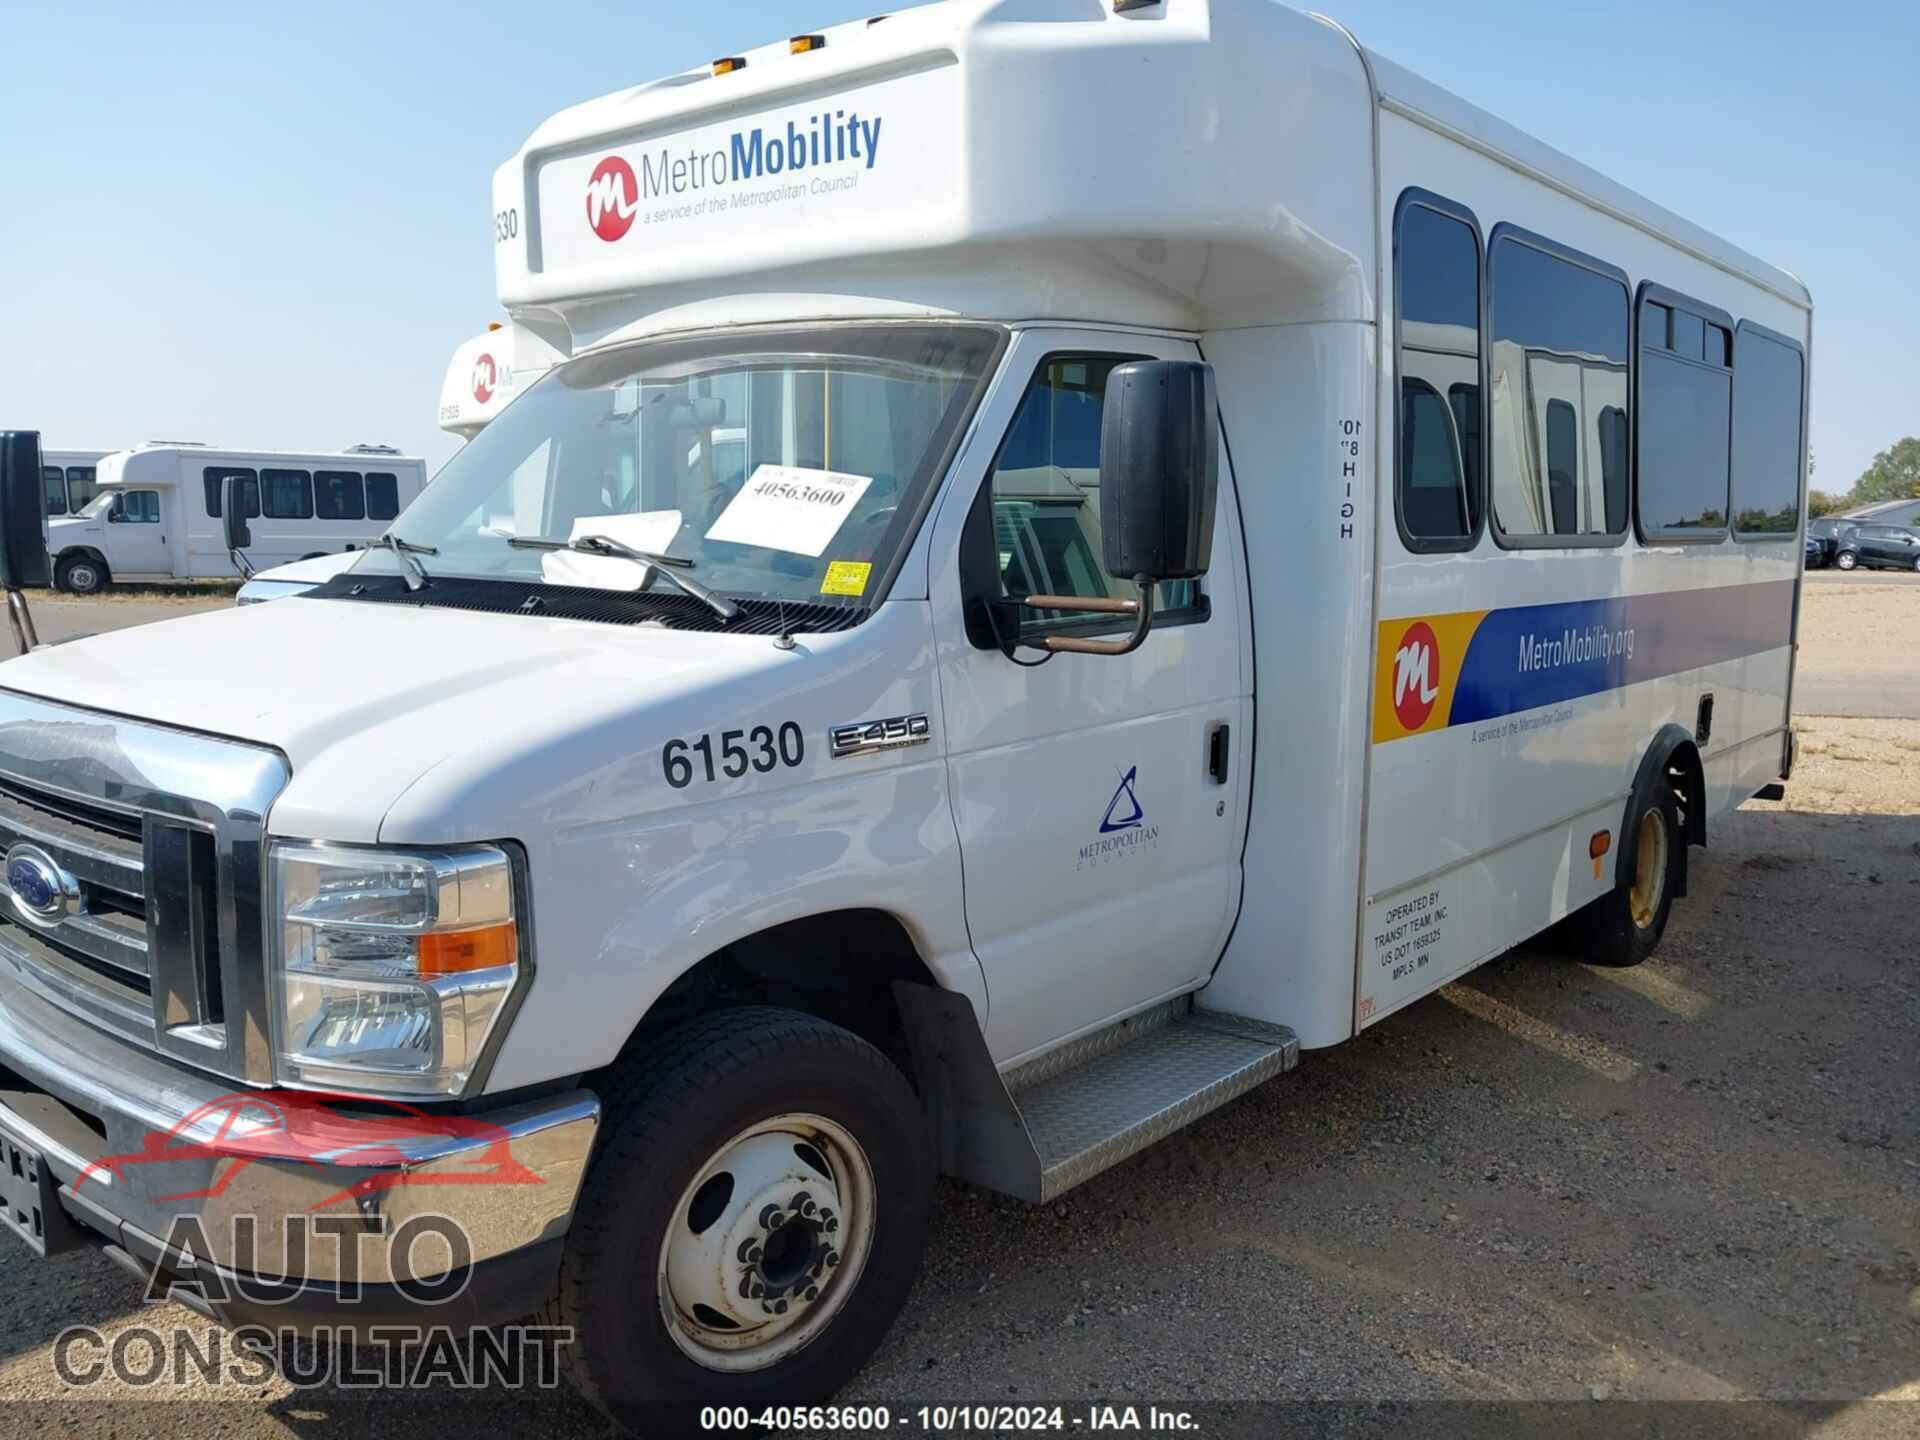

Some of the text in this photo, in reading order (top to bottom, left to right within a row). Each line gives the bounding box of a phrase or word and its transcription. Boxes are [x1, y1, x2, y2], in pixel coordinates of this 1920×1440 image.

[642, 109, 882, 199] MetroMobility
[643, 170, 858, 224] a service of the Metropolitan Council
[753, 480, 846, 506] 40563600
[1518, 624, 1634, 673] MetroMobility.org
[662, 720, 805, 789] 61530
[1079, 824, 1160, 859] METROPOLITAN
[1386, 891, 1440, 924] OPERATED BY
[1374, 924, 1408, 949] TRANSIT
[1381, 950, 1392, 967] US
[1394, 942, 1411, 960] DOT
